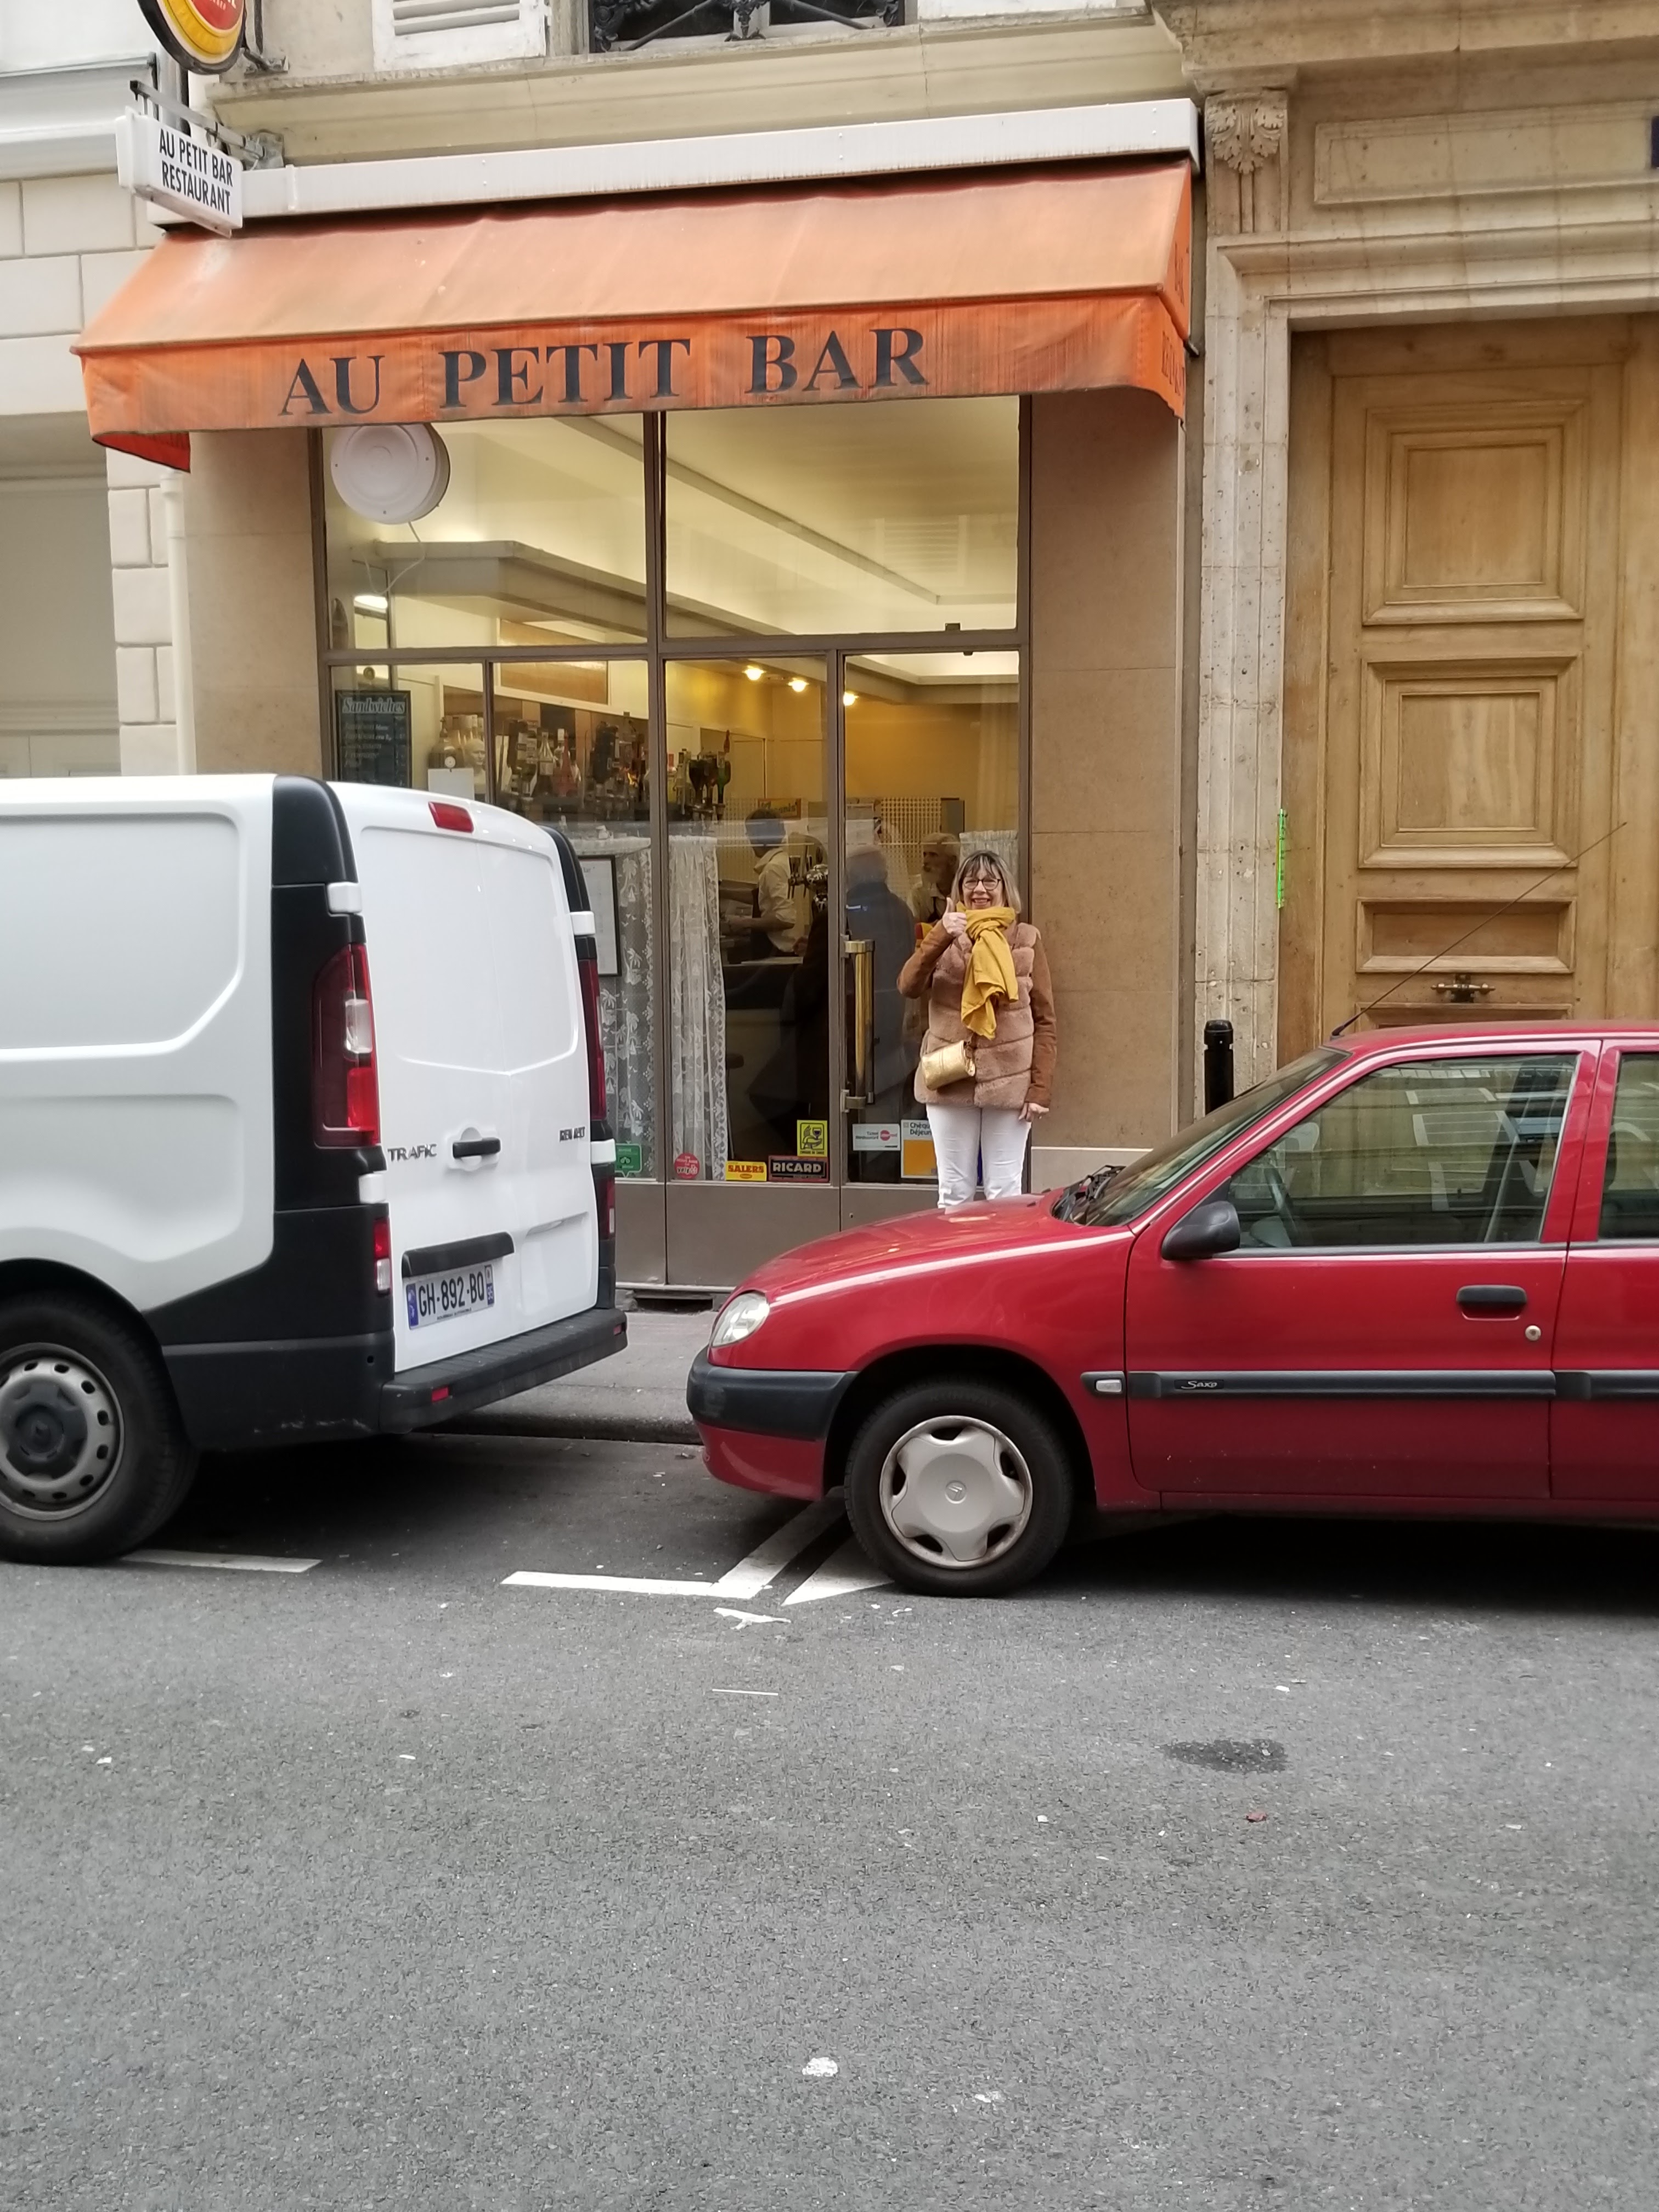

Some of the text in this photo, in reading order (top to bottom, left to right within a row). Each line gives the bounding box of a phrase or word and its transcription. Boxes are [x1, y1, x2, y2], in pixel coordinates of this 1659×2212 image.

[159, 128, 233, 187] AU PETIT BAR
[161, 161, 231, 215] RESTAURANT
[280, 328, 929, 416] AU PETIT BAR
[345, 697, 405, 713] Sandwiches
[387, 1144, 437, 1162] TRAFIC
[727, 1165, 764, 1173] SALERS
[772, 1161, 822, 1173] RICARD
[1181, 1380, 1217, 1389] Saxo
